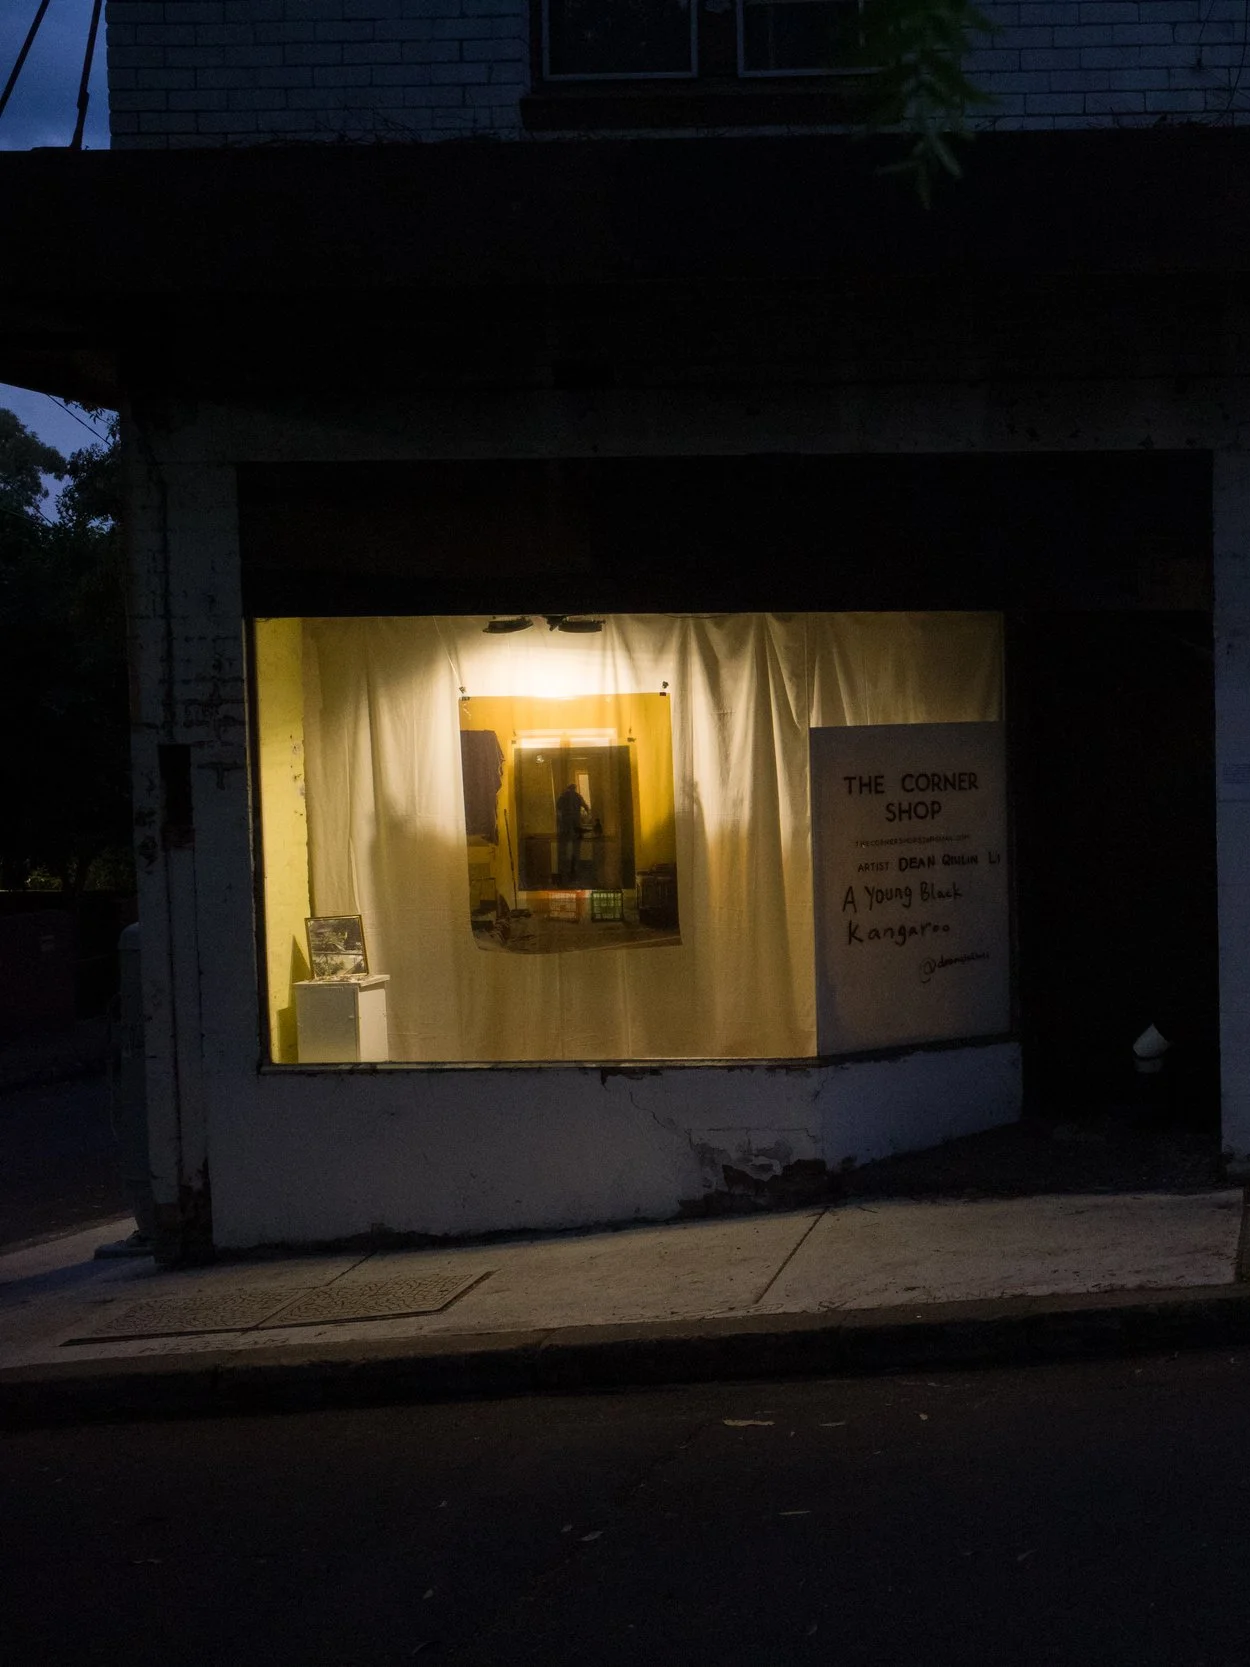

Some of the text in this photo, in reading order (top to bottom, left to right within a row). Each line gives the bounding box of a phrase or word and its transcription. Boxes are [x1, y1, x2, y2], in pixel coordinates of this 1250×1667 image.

[843, 772, 979, 795] THE CORNER
[885, 800, 942, 822] SHOP
[857, 861, 889, 873] ARTIST
[898, 855, 936, 872] DEAN
[842, 885, 858, 913] A
[919, 881, 963, 902] Black
[847, 919, 951, 946] Kangaroo
